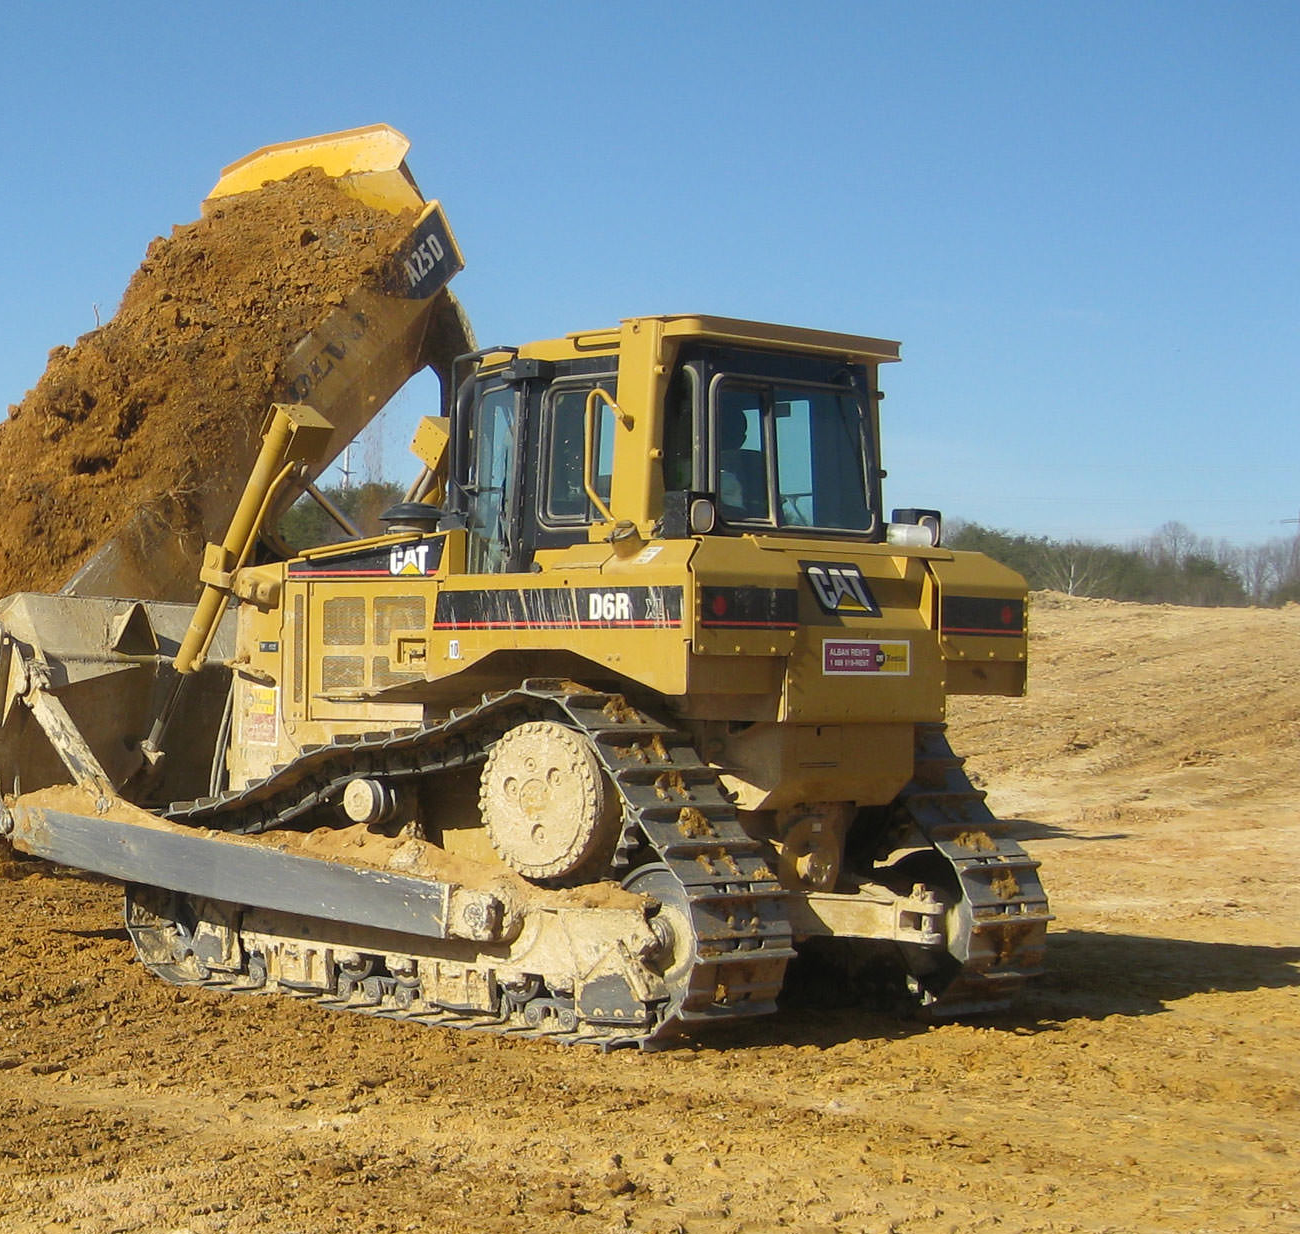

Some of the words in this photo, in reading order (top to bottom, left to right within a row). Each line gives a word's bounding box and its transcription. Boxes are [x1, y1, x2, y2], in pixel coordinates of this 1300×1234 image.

[404, 234, 444, 287] A25D
[390, 545, 429, 575] CAT
[589, 593, 629, 620] D6R
[807, 567, 873, 611] CAT
